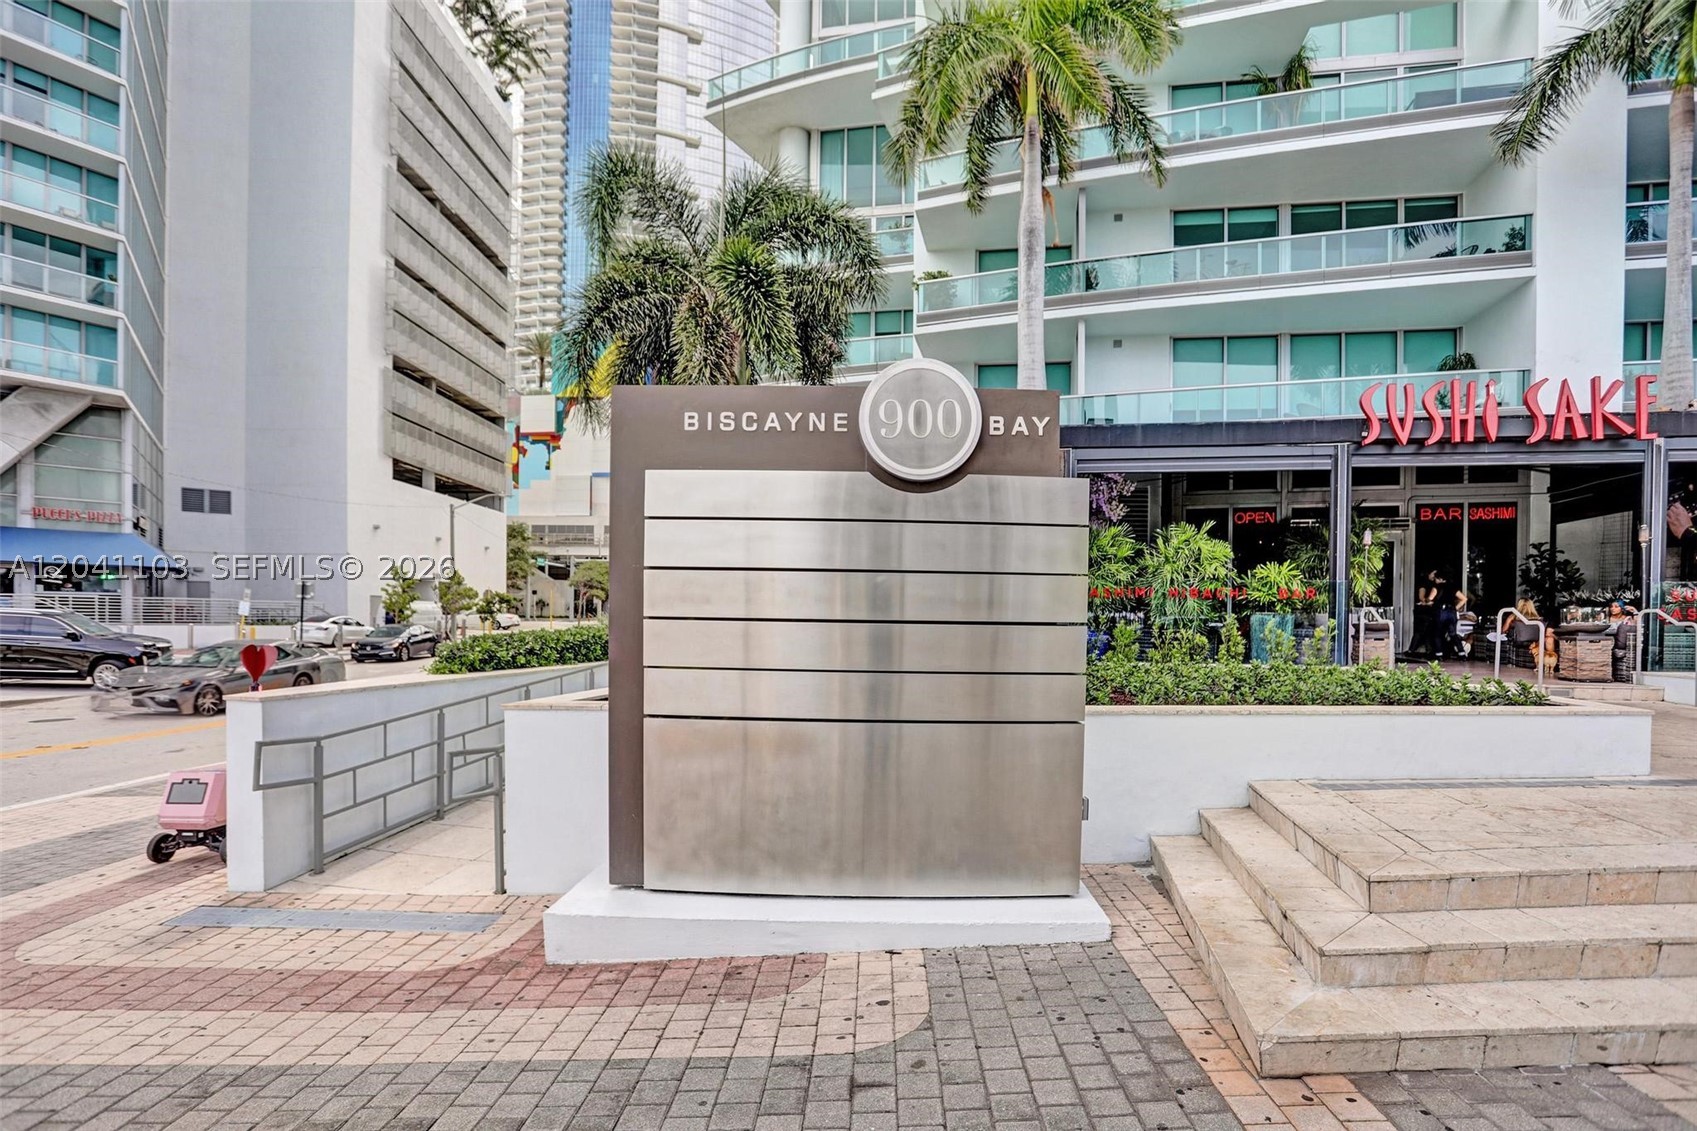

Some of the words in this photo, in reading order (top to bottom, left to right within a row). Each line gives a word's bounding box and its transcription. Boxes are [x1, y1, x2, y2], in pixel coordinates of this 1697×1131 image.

[1523, 375, 1658, 445] SAKE
[683, 411, 849, 433] BISCAYNE
[877, 398, 963, 440] 900
[988, 415, 1051, 436] BAY
[1234, 511, 1276, 524] OPEN
[1420, 507, 1462, 521] BAR
[1469, 506, 1516, 521] SASHIMI
[1168, 586, 1248, 599] HIBACHI
[1278, 586, 1317, 600] BAR
